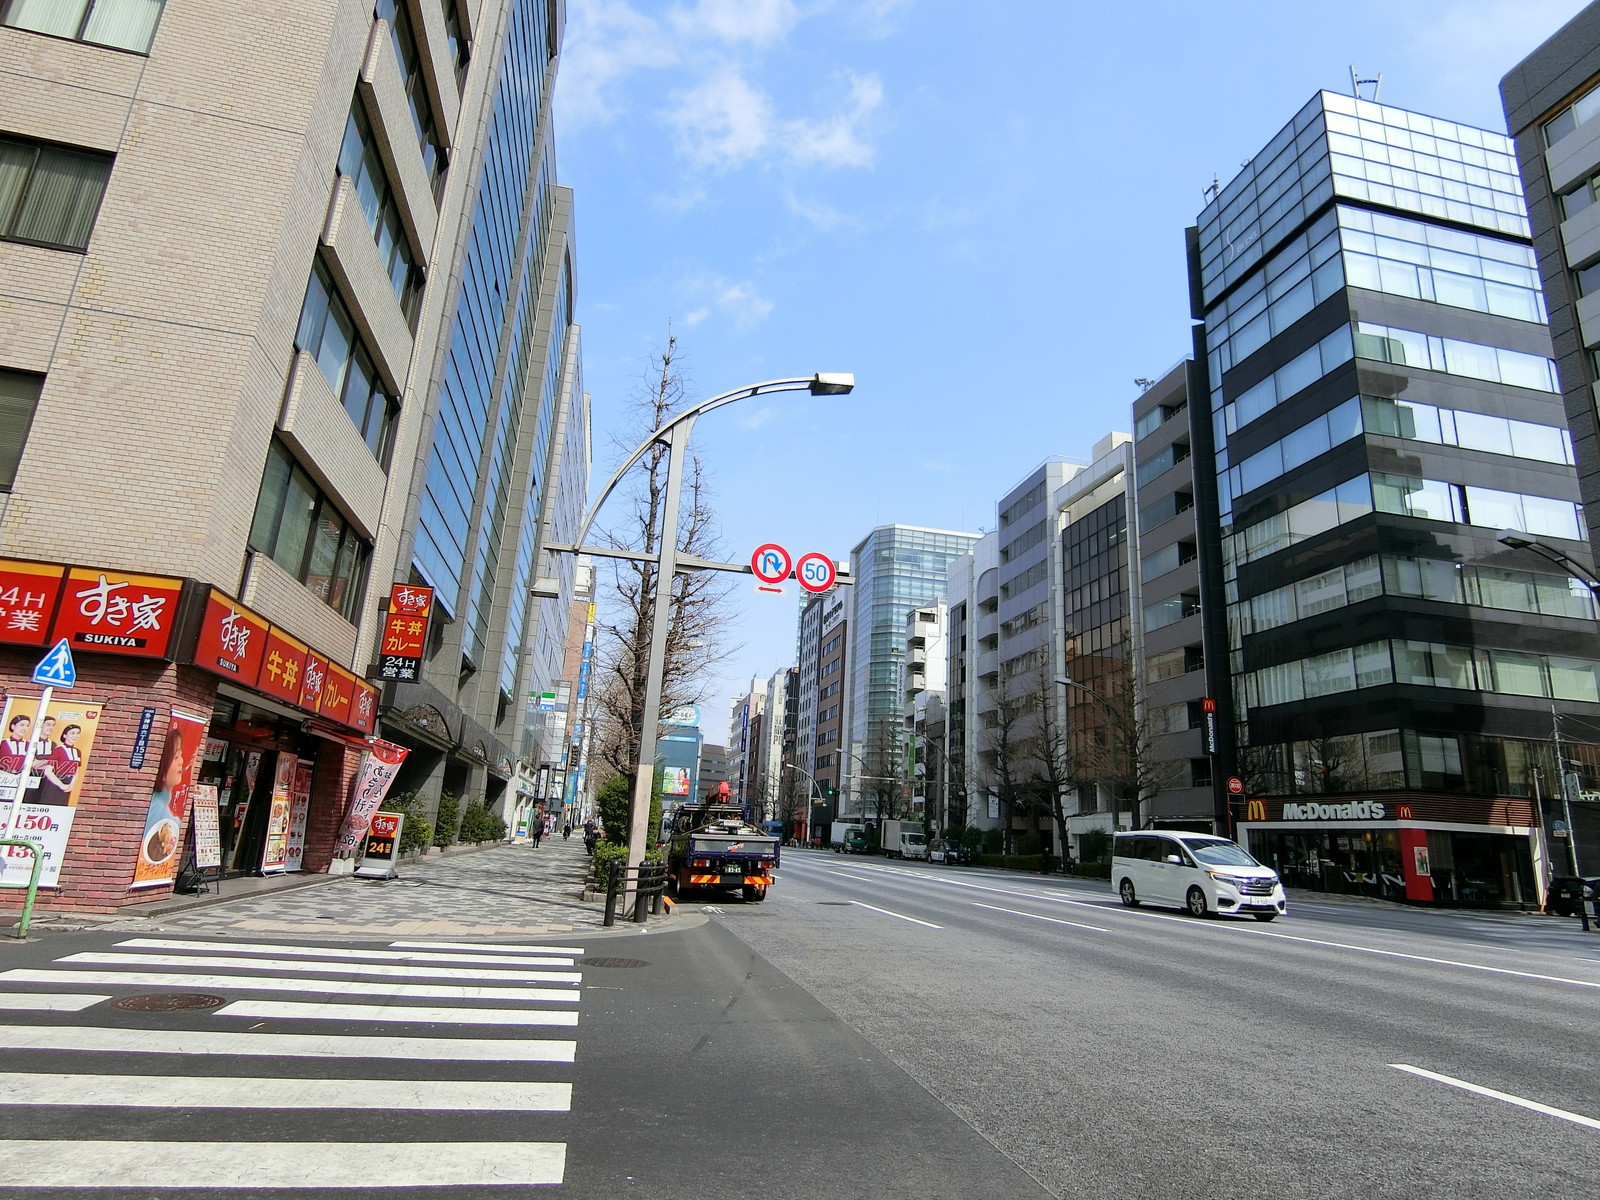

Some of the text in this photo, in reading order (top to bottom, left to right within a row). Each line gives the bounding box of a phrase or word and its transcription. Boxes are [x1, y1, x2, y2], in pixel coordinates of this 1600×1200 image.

[805, 562, 827, 582] 50
[0, 585, 46, 609] 4H
[75, 574, 167, 635] すき家
[396, 587, 428, 609] すき家
[0, 606, 43, 632] 業
[390, 619, 423, 636] 牛丼
[84, 633, 137, 647] SUKIYA
[221, 604, 250, 660] すき家
[386, 635, 421, 652] カレー
[267, 650, 299, 691] 牛丼
[382, 666, 416, 680] 営業
[385, 656, 416, 668] 24H
[306, 657, 324, 696] すき家
[324, 680, 349, 709] カレー
[359, 686, 374, 720] すき家
[1207, 712, 1215, 753] McDonald's
[135, 746, 146, 754] 15
[0, 755, 79, 781] SUIYA
[1282, 800, 1386, 820] McDonald's
[374, 816, 396, 832] すき家
[368, 842, 384, 853] 24
